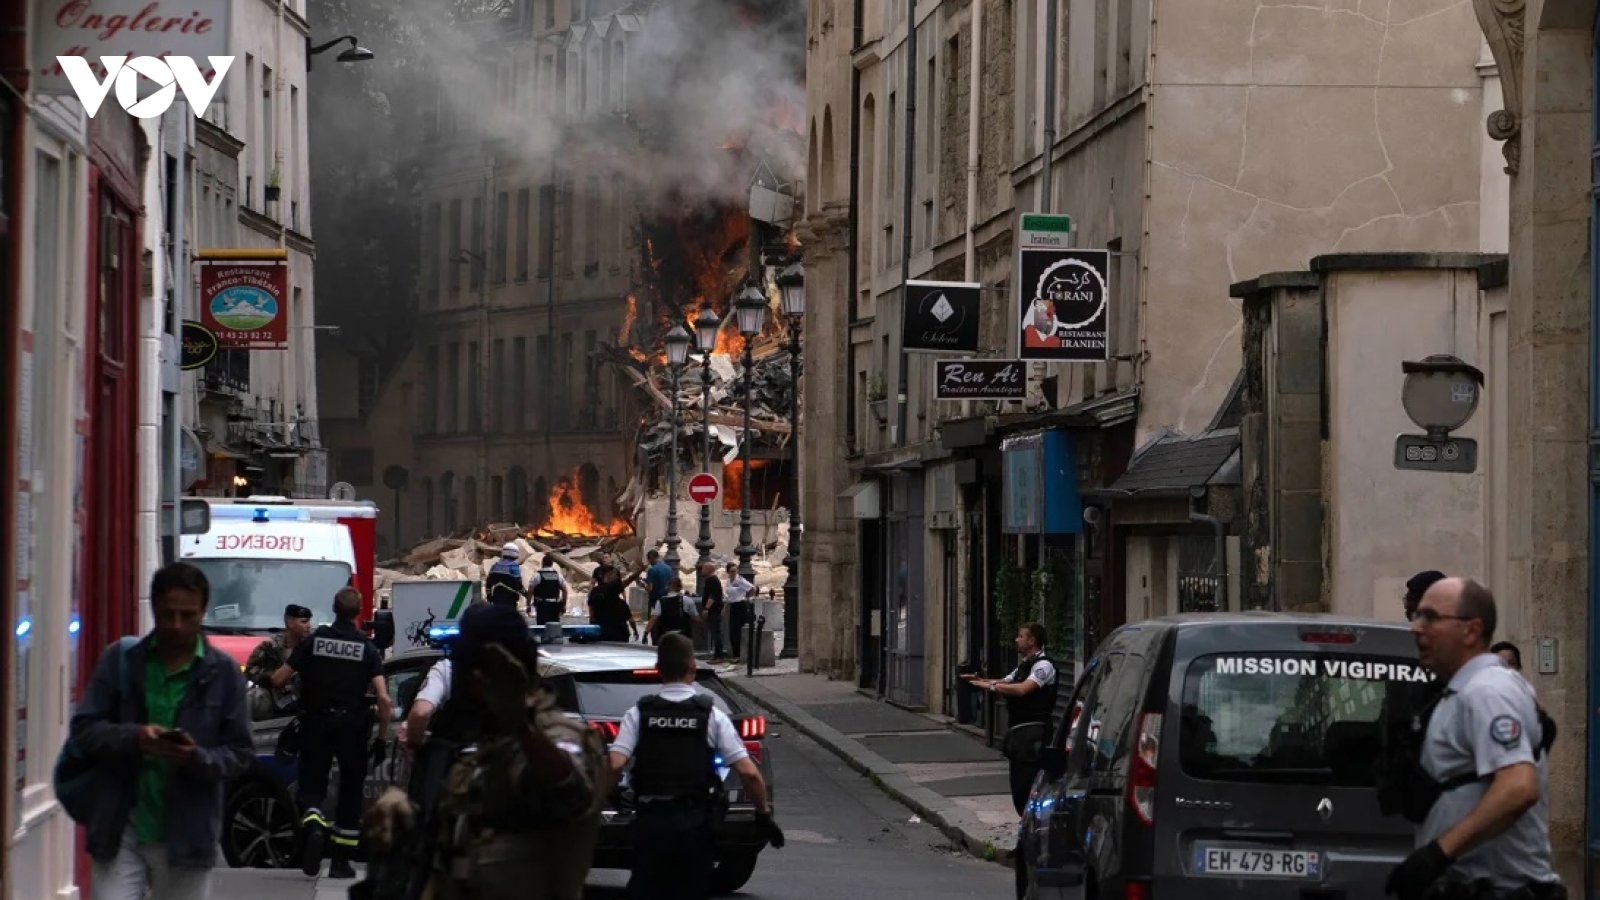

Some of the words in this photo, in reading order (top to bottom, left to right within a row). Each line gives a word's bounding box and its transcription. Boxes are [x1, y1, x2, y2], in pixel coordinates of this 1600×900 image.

[54, 0, 213, 41] Onglerie
[1030, 233, 1060, 246] Iranien
[217, 268, 271, 279] Restaurant
[1048, 290, 1094, 303] TORANJ
[1058, 330, 1107, 338] RESTAURANT
[1061, 339, 1105, 349] IRANIEN
[944, 363, 985, 383] Ren
[990, 363, 1020, 384] Ai
[940, 384, 978, 394] Traiteur
[315, 640, 362, 658] POLICE
[1216, 656, 1317, 677] MISSION
[1323, 660, 1438, 683] VIGIPIRA
[648, 716, 698, 729] POLICE
[1208, 850, 1305, 874] EM-479-RG
